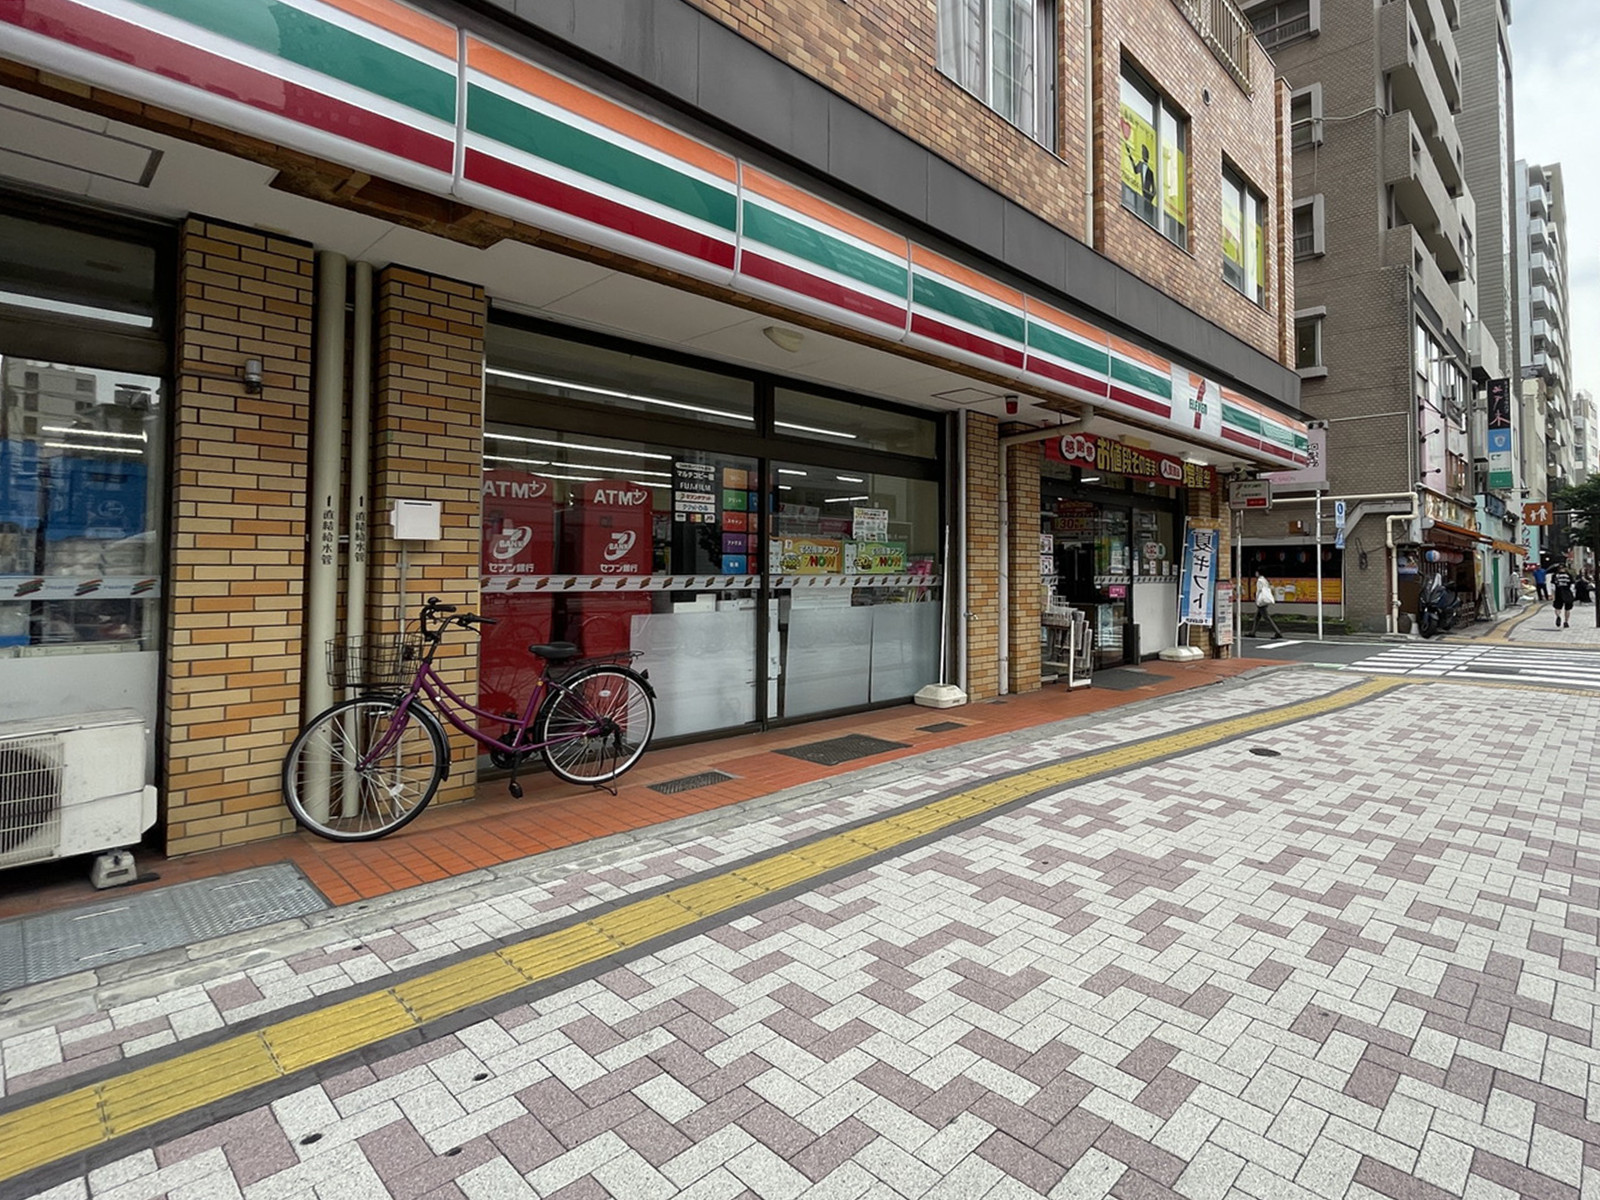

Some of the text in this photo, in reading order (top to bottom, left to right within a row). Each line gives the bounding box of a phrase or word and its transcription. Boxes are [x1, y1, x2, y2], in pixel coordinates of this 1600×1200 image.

[483, 480, 529, 499] ATM
[594, 489, 633, 506] ATM
[488, 563, 535, 573] セブン銀行
[600, 563, 638, 573] セブン銀行
